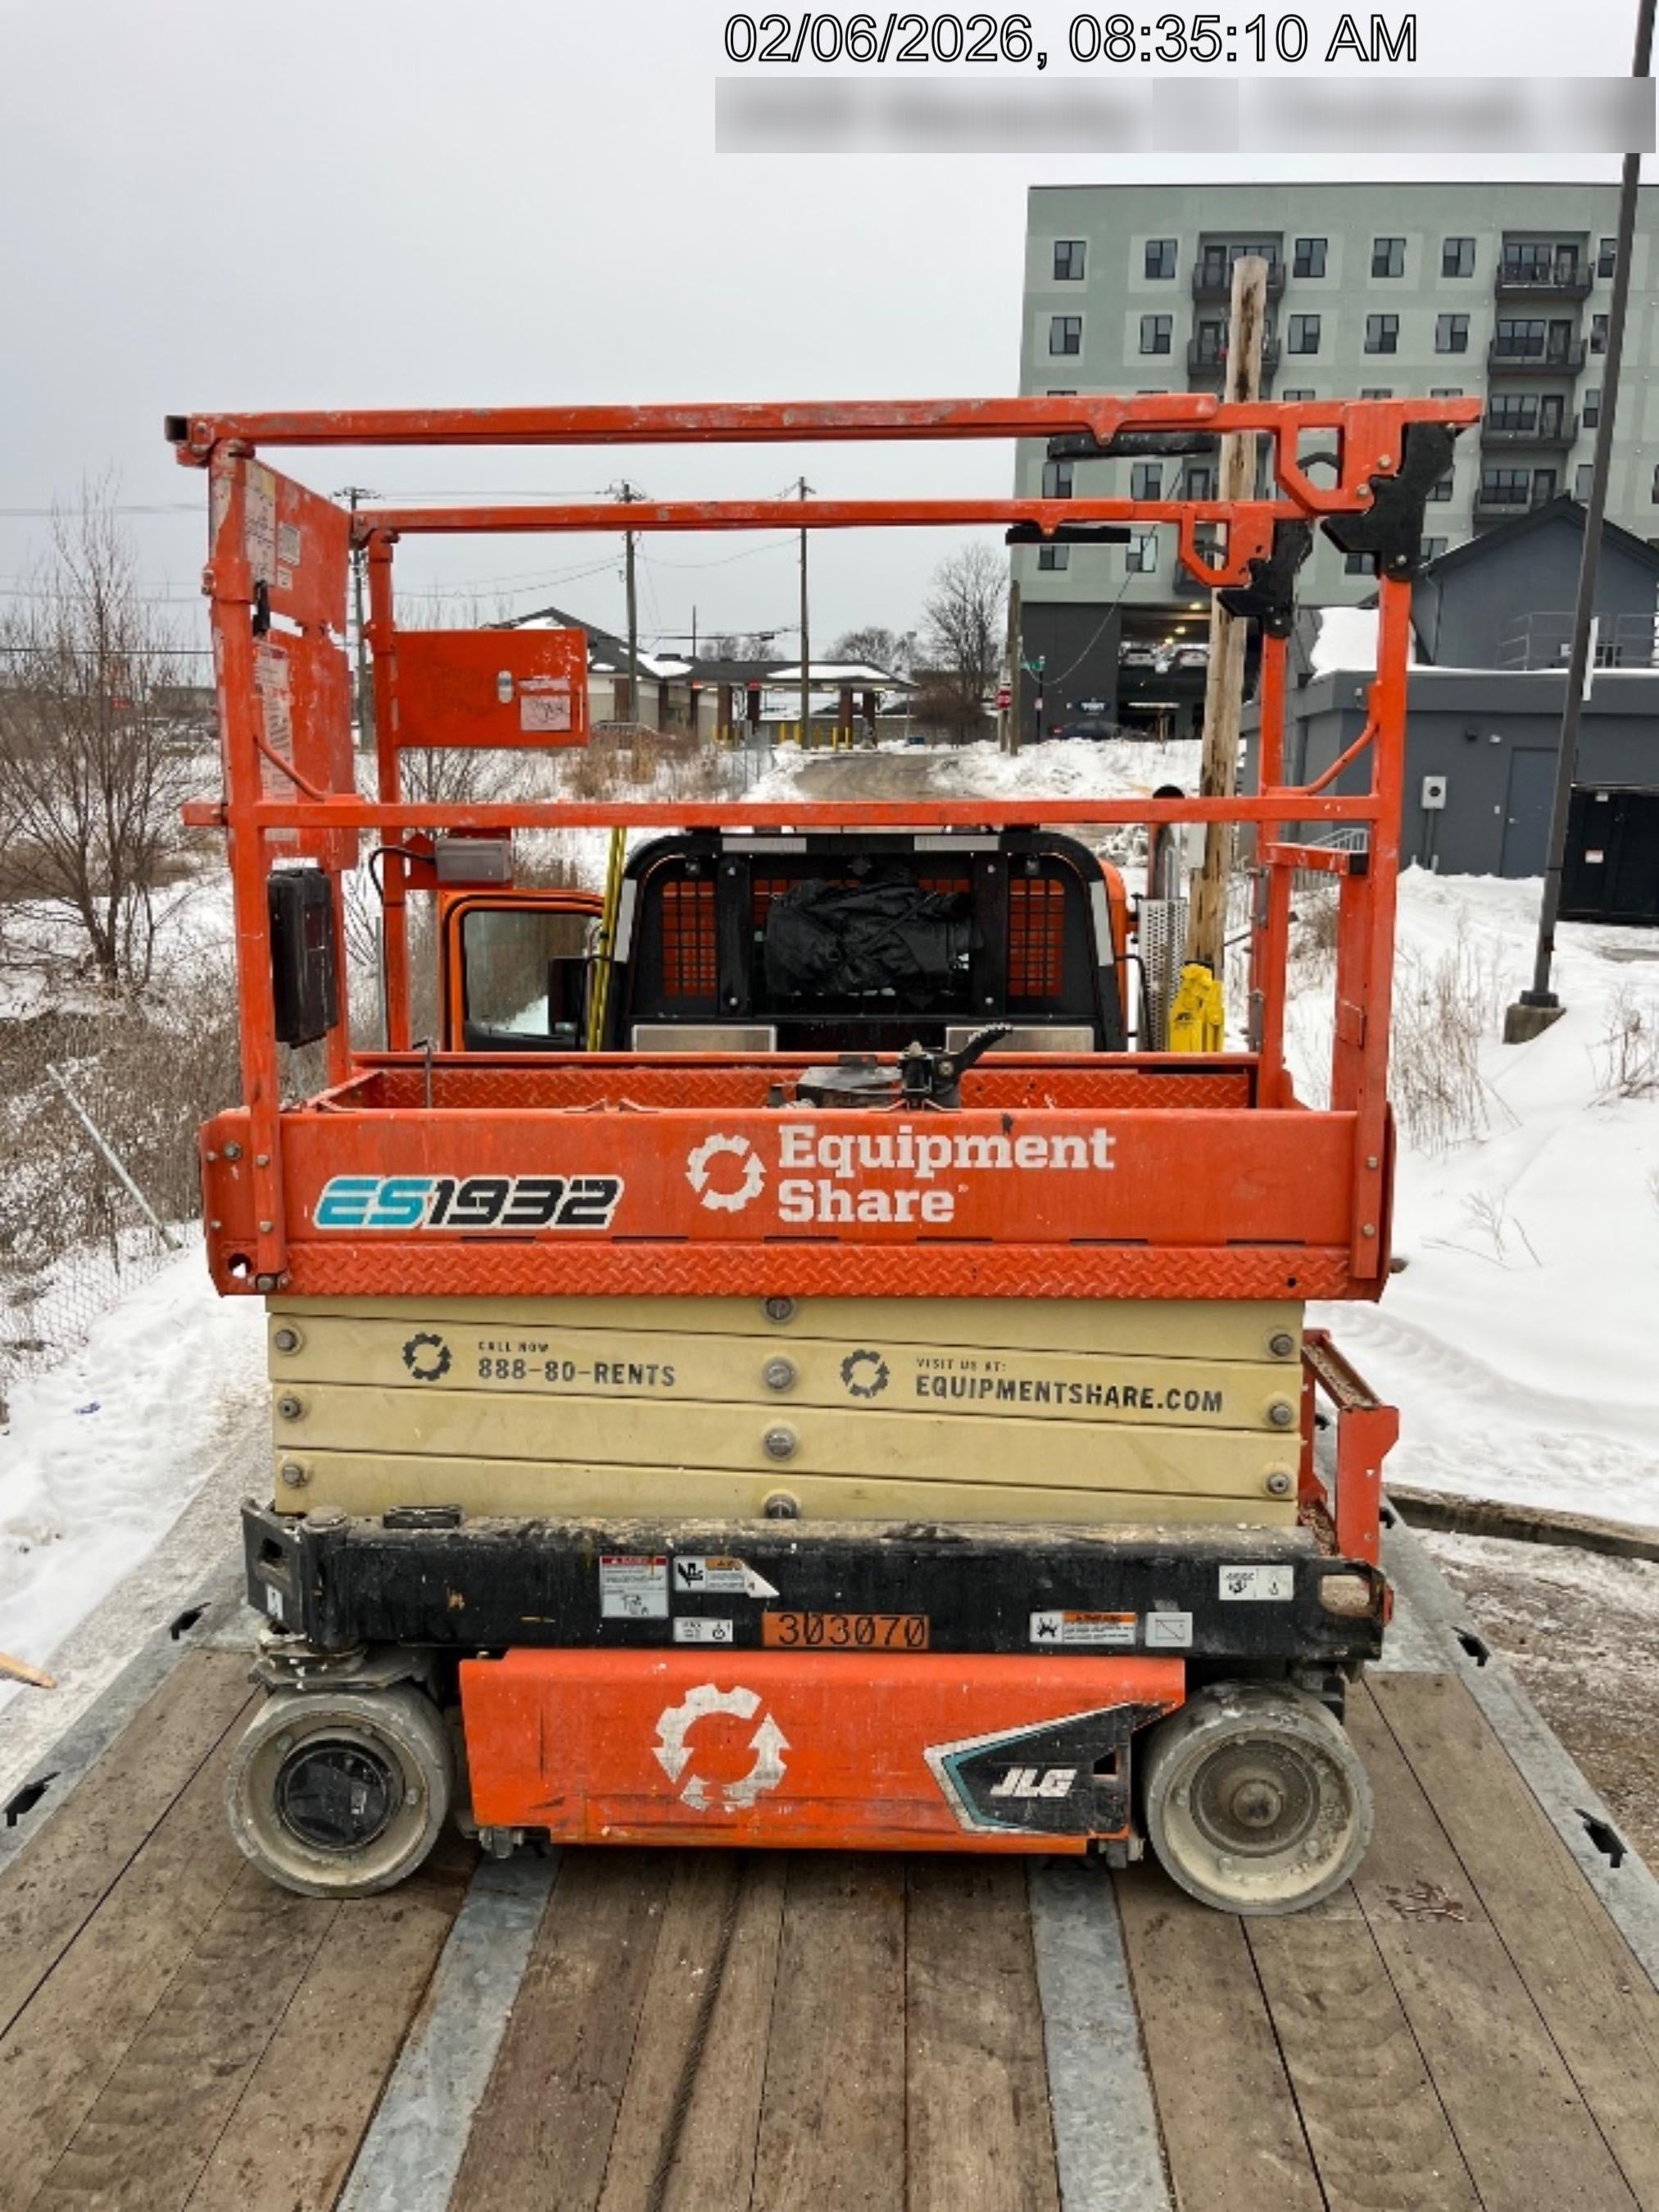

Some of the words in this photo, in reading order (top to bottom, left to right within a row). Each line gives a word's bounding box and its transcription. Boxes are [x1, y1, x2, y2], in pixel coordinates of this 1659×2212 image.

[778, 1125, 1116, 1178] Equipment
[312, 1174, 625, 1230] ES1932
[777, 1180, 955, 1222] Share
[478, 1341, 511, 1353] CALL
[518, 1341, 549, 1353] NOW
[478, 1358, 676, 1387] 888-80-RENTS
[916, 1358, 954, 1371] VISIT
[960, 1360, 977, 1372] US
[915, 1375, 1223, 1412] EQUIPMENTSHARE.COM
[778, 1613, 926, 1648] 303070
[989, 1766, 1078, 1798] JLG
